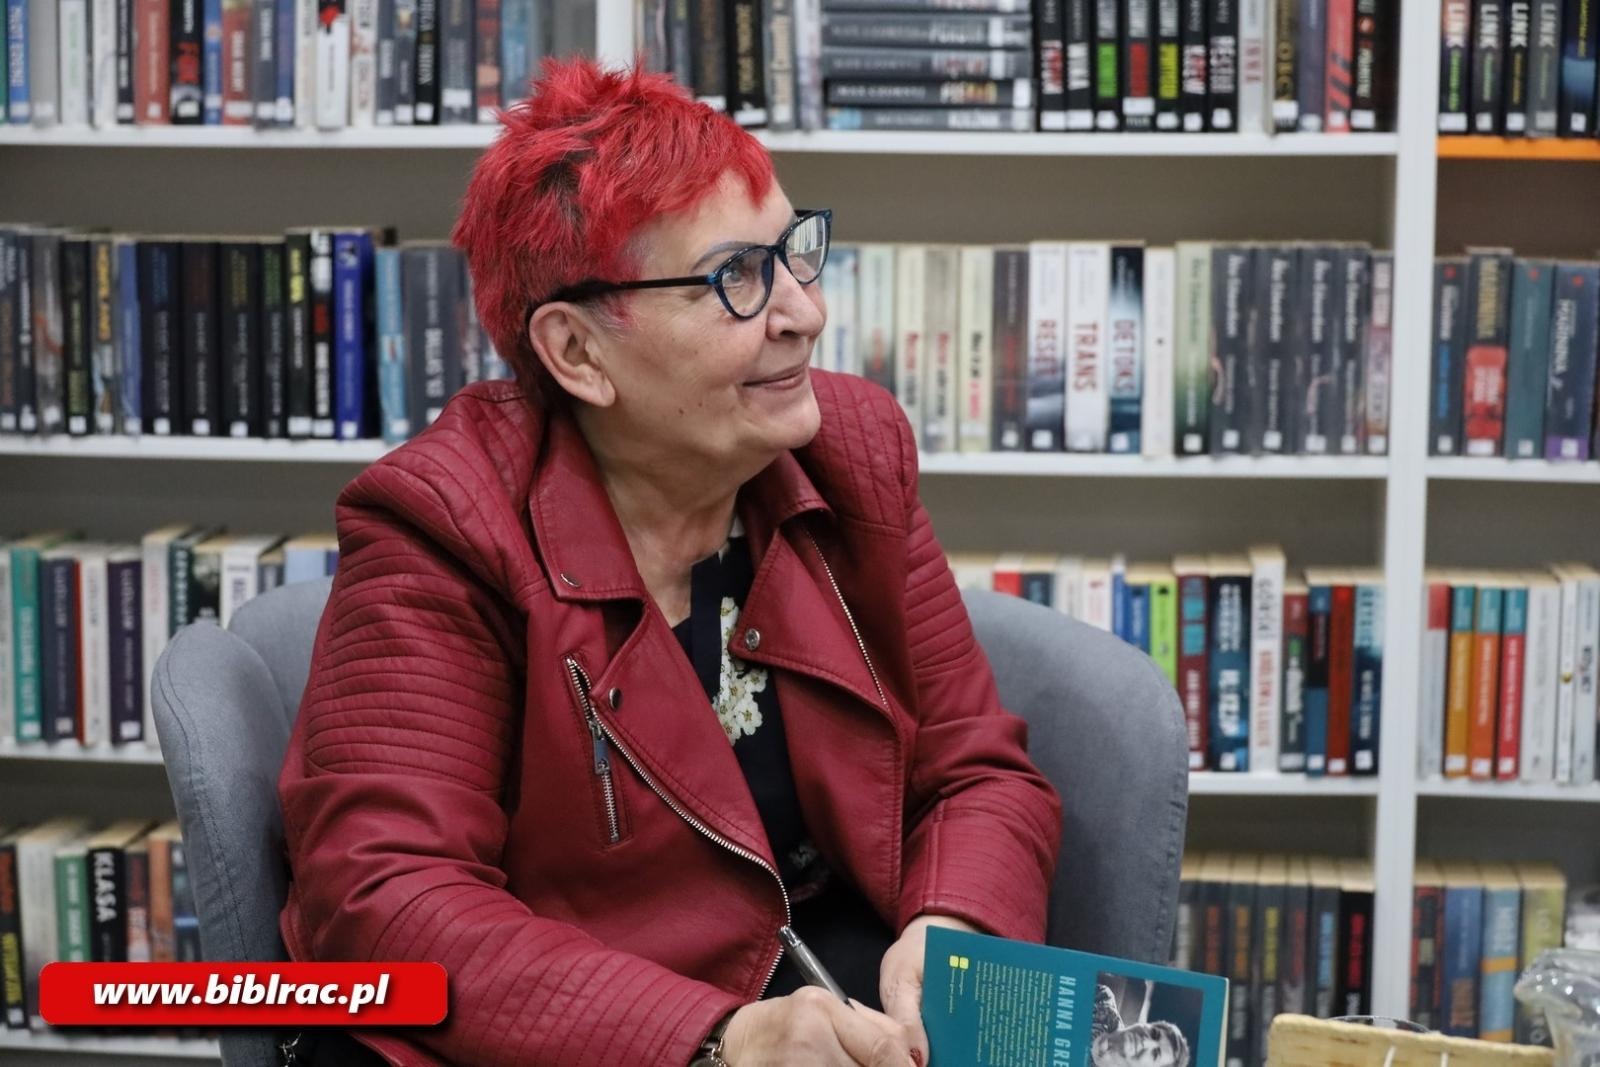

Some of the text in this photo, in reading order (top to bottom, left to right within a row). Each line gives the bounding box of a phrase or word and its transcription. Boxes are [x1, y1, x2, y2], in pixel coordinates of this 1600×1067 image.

[1446, 2, 1465, 48] LINK
[1480, 3, 1499, 49] LINK
[1510, 2, 1528, 48] LINK
[1538, 2, 1556, 48] LINK
[1035, 320, 1057, 377] RESET
[1073, 321, 1097, 391] TRANS
[1113, 320, 1137, 393] DETOKS
[94, 851, 117, 922] KLASA
[1056, 975, 1077, 1030] HANNA
